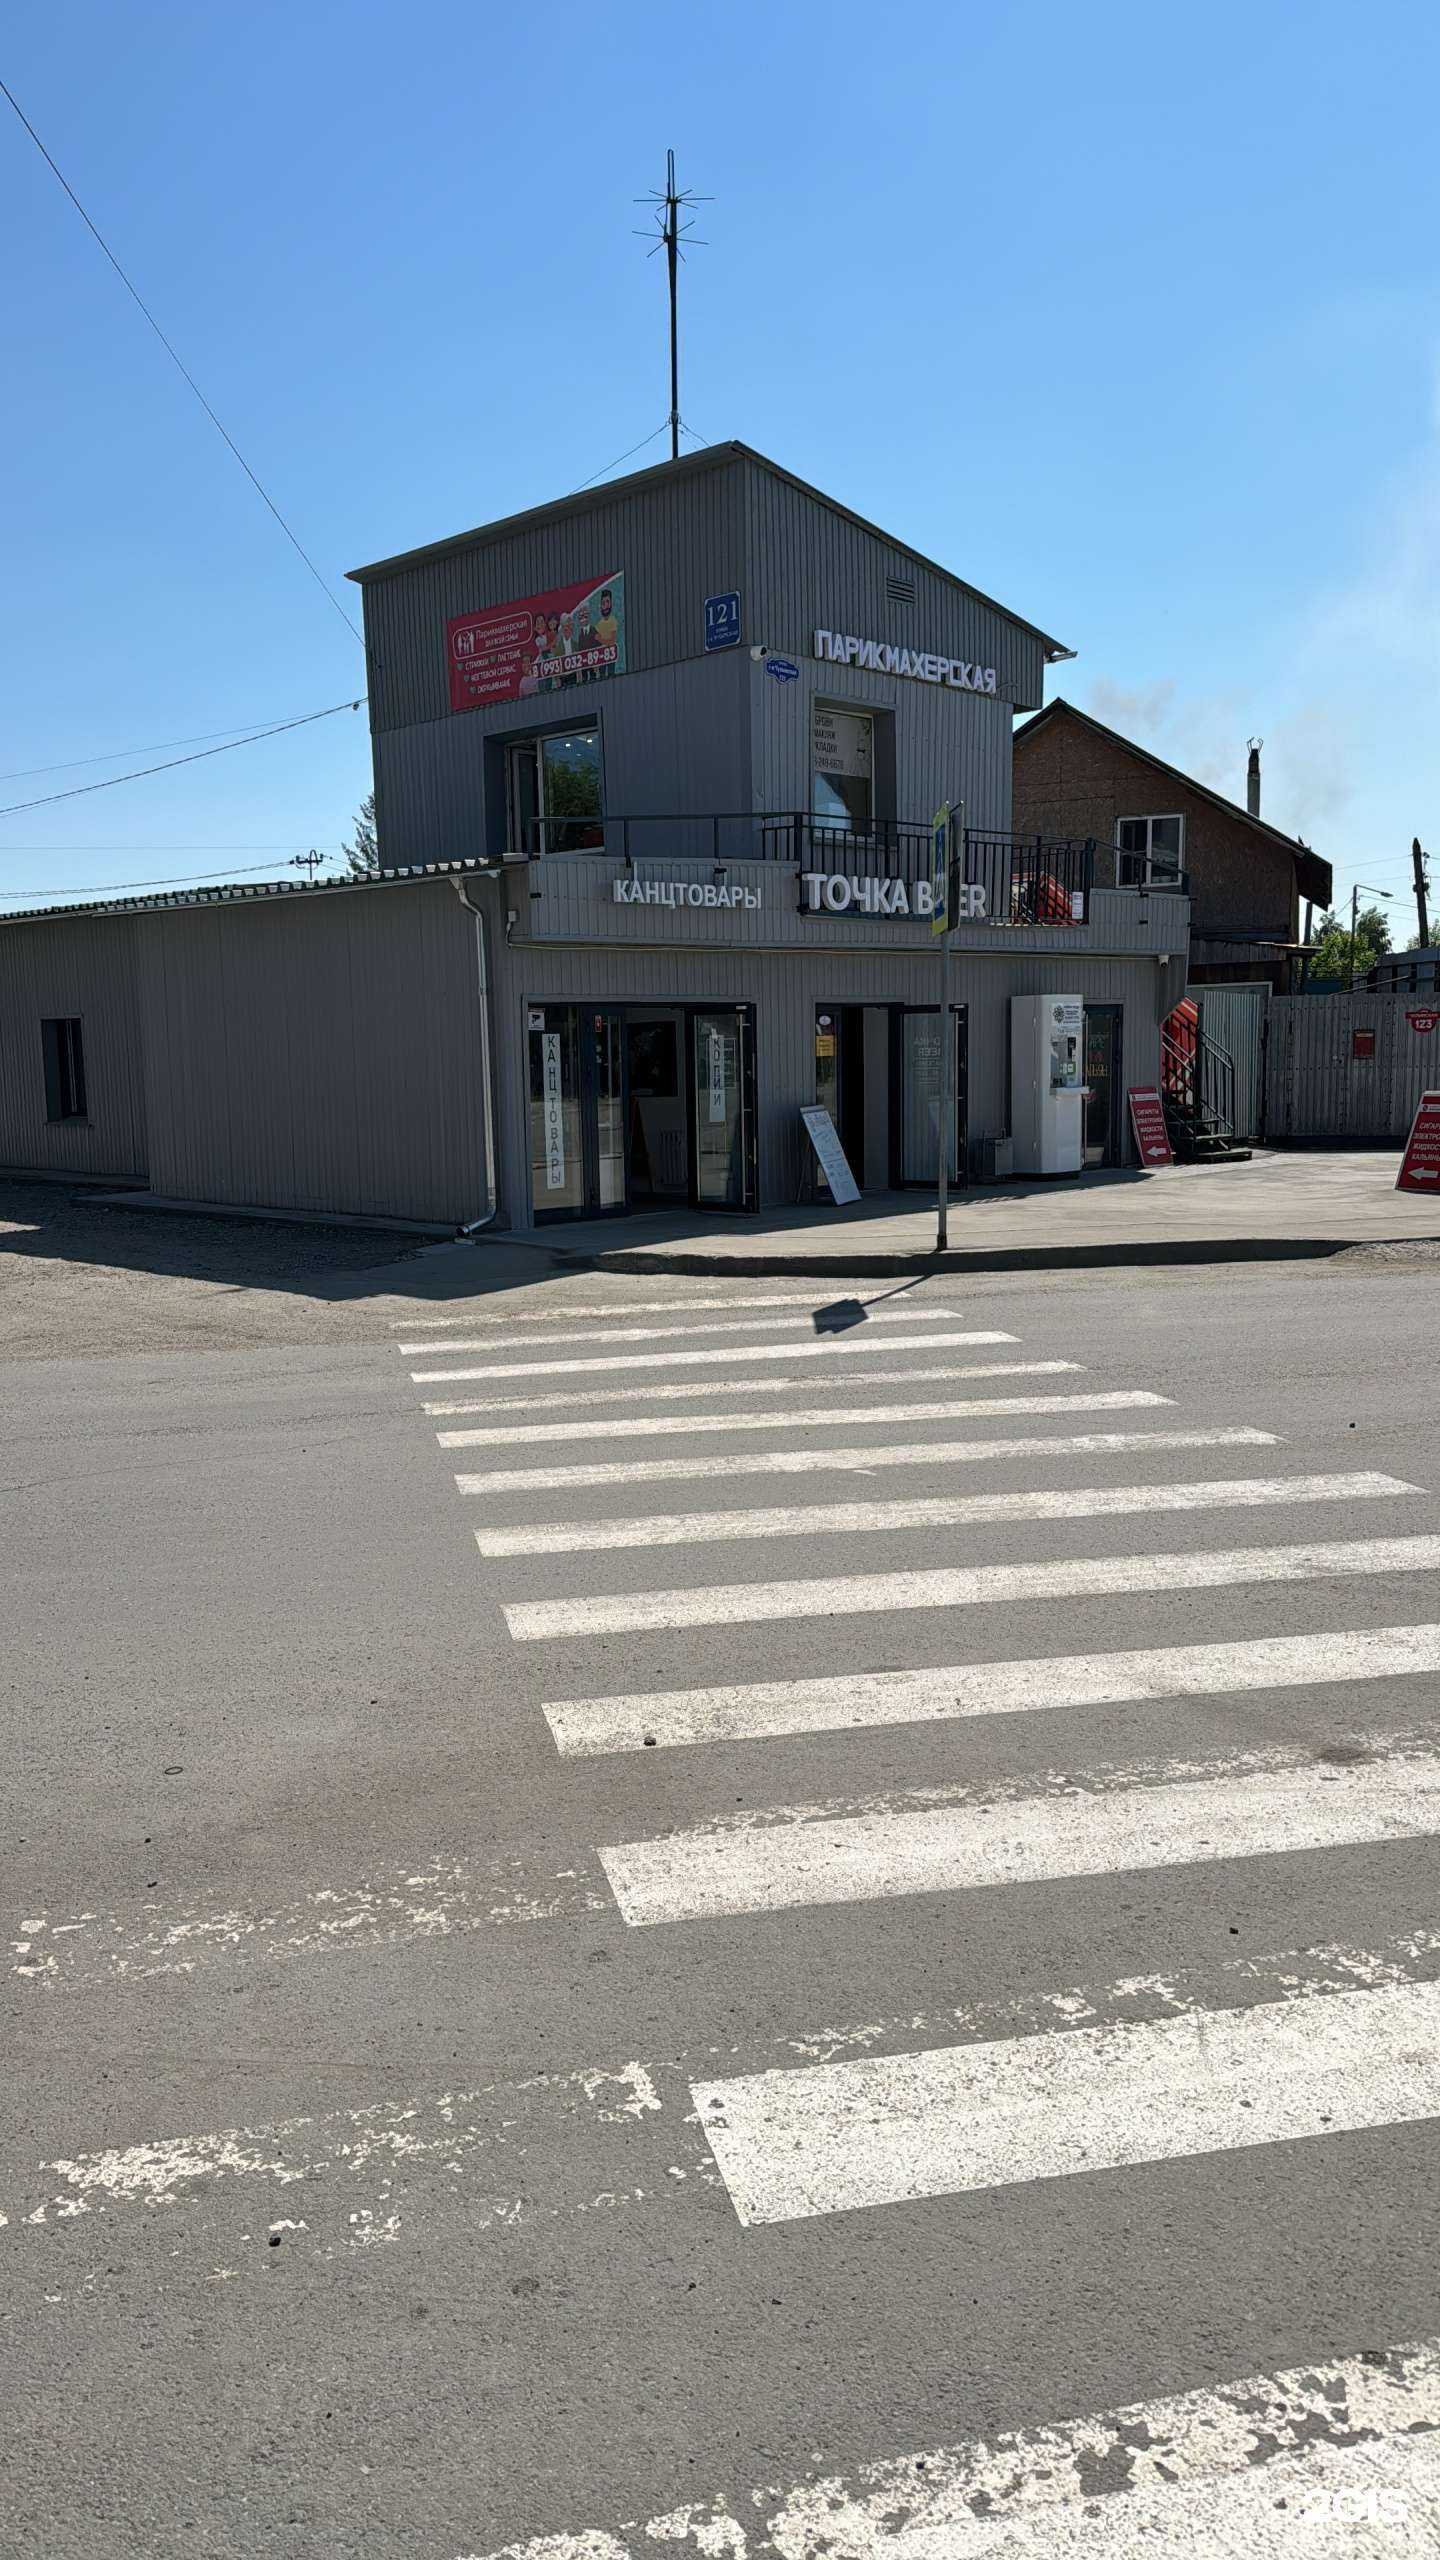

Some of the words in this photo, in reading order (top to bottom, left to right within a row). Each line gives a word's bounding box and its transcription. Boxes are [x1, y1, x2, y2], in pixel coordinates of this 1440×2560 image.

[708, 600, 737, 626] 121
[532, 665, 539, 678] 8
[540, 657, 563, 677] (993)
[564, 650, 616, 670] 032-89-83
[814, 629, 997, 694] ПАРИКМАХЕРСКАЯ
[613, 879, 762, 909] КАНЦТОВАРЫ
[802, 873, 910, 914] ТОЧКА
[914, 880, 986, 918] BER
[1415, 1019, 1433, 1029] 123
[713, 1039, 722, 1106] КОПИИ
[546, 1035, 561, 1184] КАНЦТОВАРЫ
